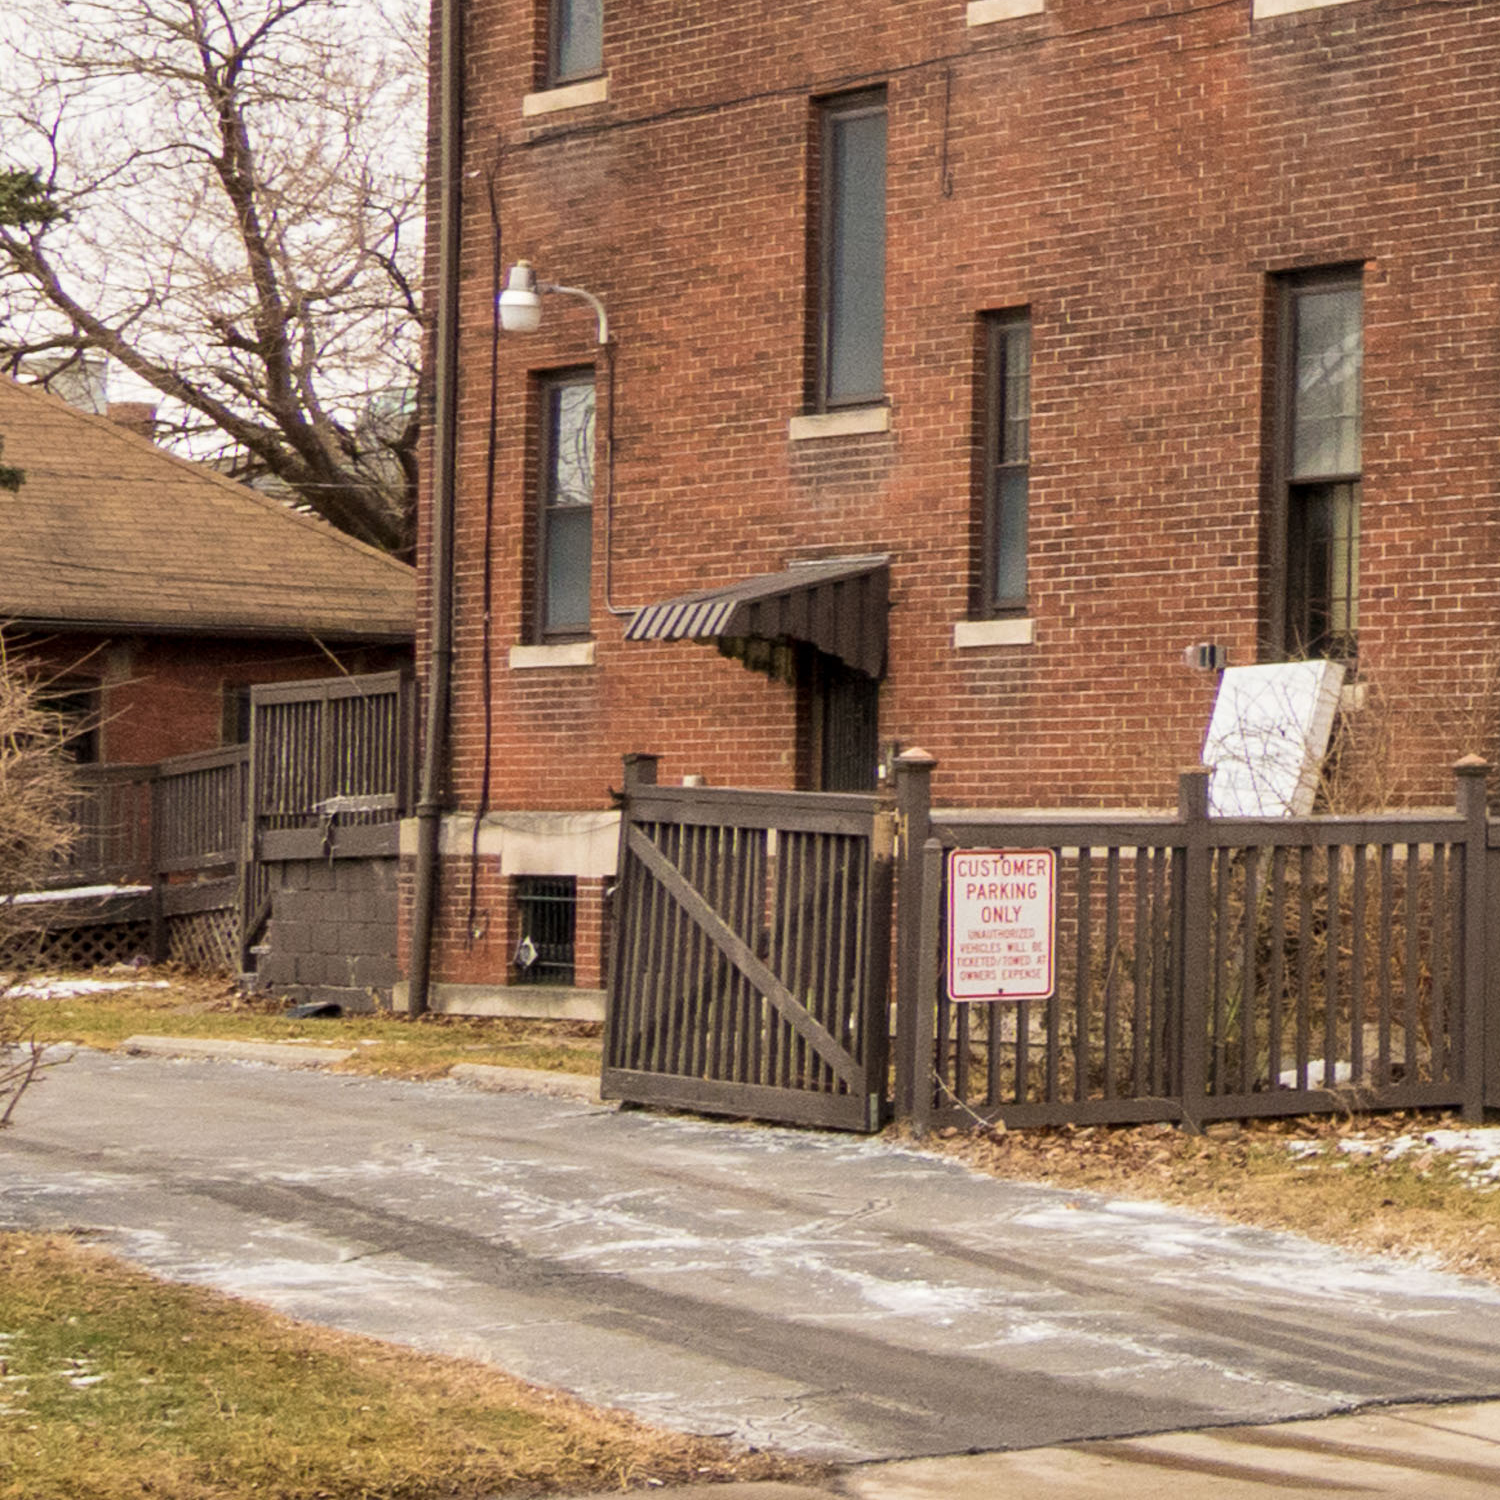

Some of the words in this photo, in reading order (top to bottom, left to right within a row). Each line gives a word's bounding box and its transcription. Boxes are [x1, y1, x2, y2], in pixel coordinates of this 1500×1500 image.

[957, 859, 1047, 877] CUSTOMER
[966, 882, 1037, 900] PARKING
[981, 906, 1022, 924] ONLY
[968, 928, 1035, 939] UNAUTHORIZED
[960, 943, 1001, 954] VEHICLES
[1007, 942, 1026, 952] WILL
[1032, 941, 1042, 952] BE
[1036, 955, 1047, 965] AT
[1002, 968, 1042, 980] EXPENSE
